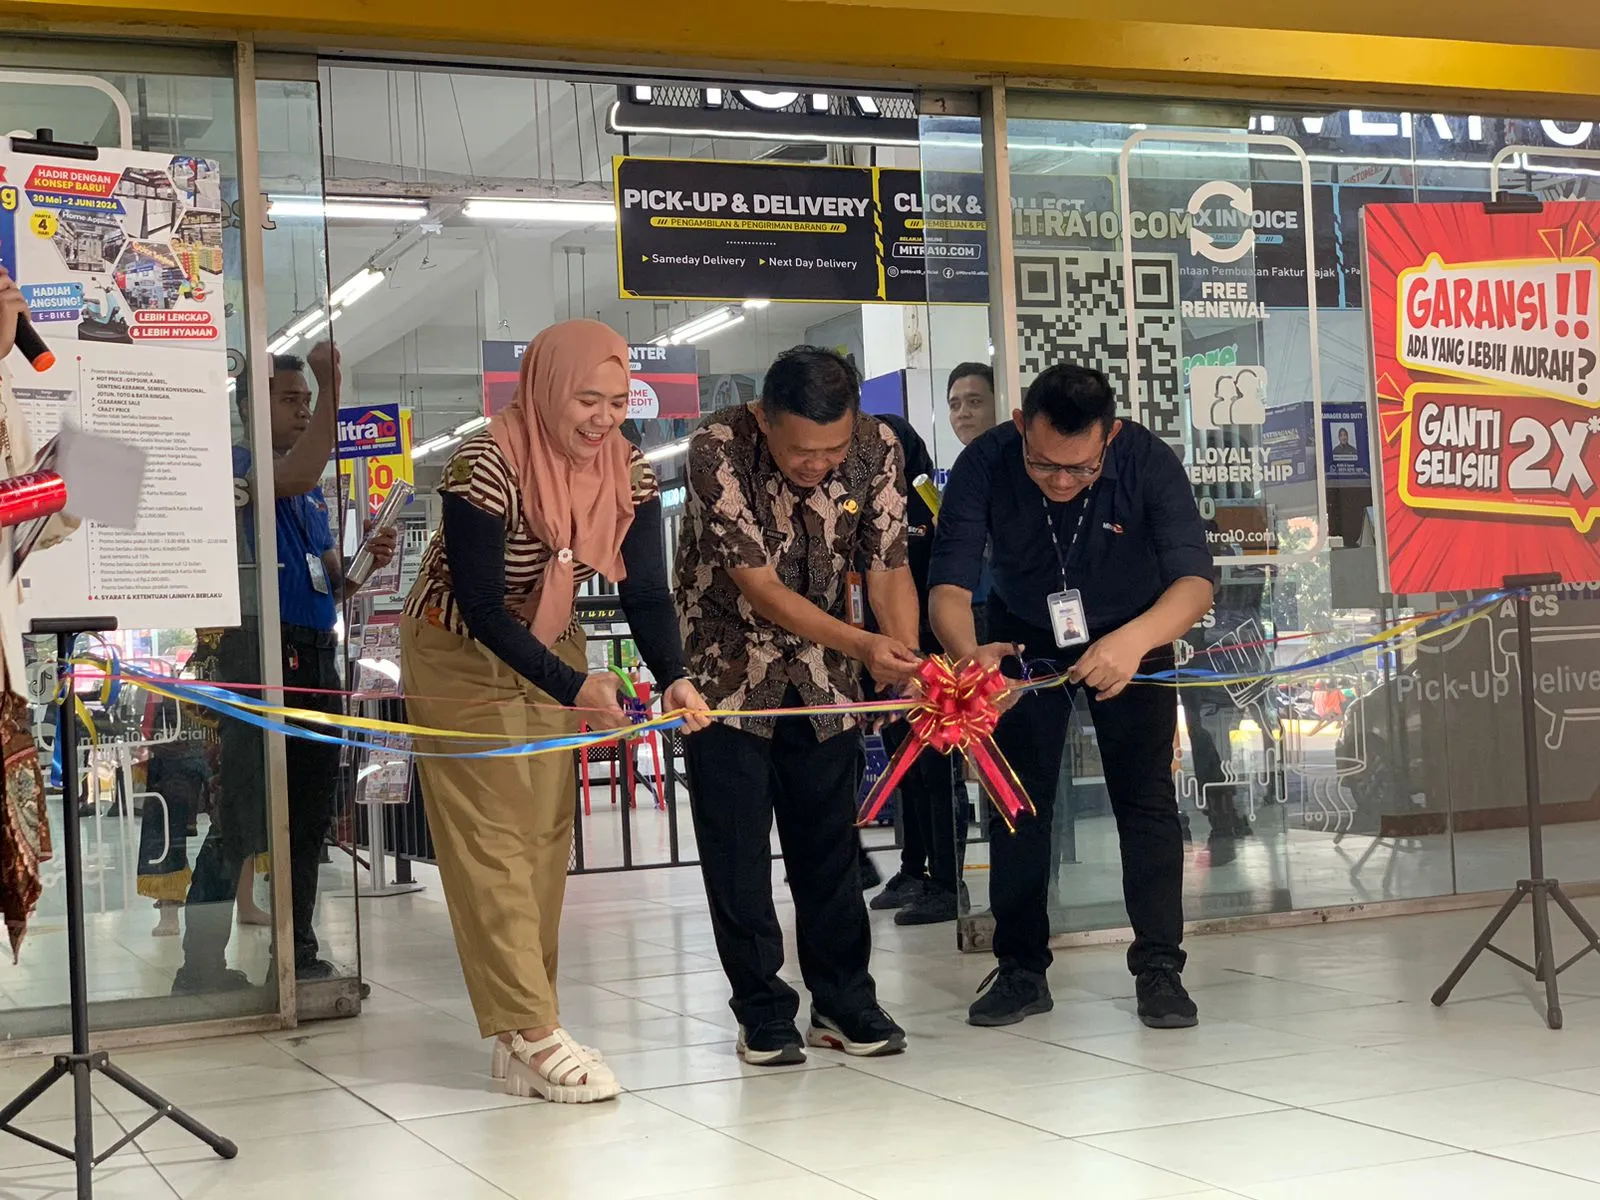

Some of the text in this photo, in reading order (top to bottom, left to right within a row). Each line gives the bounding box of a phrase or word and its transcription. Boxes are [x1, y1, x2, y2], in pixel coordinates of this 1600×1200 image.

[38, 169, 111, 184] HADIR DENGAN
[34, 178, 106, 192] KONSEP BARU!
[33, 194, 44, 202] 30
[46, 196, 62, 204] Mei
[75, 200, 95, 208] JUNI
[96, 200, 118, 210] 2024
[623, 188, 869, 217] PICK-UP & DELIVERY
[894, 192, 983, 214] CLICK &
[38, 218, 48, 230] 4
[670, 218, 828, 232] PENGAMBILAN & PENGIRIMAN BARANG
[925, 220, 967, 229] EMBELIAN
[1014, 208, 1191, 239] ITRA10.COM
[1170, 208, 1213, 227] TX
[899, 245, 975, 257] MITRA10.COM
[652, 253, 746, 269] Sameday Delivery
[768, 257, 858, 271] Next Day Delivery
[1271, 267, 1305, 277] Faktur
[1313, 267, 1336, 280] ajak
[33, 286, 71, 296] HADIAH
[1201, 281, 1248, 299] FREE
[1181, 301, 1270, 319] RENEWAL
[1406, 277, 1548, 331] GARANSI
[39, 312, 72, 320] E-BIKE
[139, 313, 209, 322] LEBIH LENGKAP
[133, 328, 213, 337] & LEBIH NYAMAN
[628, 347, 667, 360] NTER
[1406, 334, 1428, 359] ADA
[1431, 336, 1464, 366] YANG
[1468, 340, 1507, 372] LEBIH
[628, 389, 648, 398] OME
[338, 420, 396, 441] itra10
[1418, 402, 1501, 450] GANTI
[1196, 447, 1272, 465] LOYALTY
[1414, 448, 1499, 488] SELISIH
[1205, 528, 1276, 544] itra10.com
[1398, 673, 1510, 705] Pick-Up
[1531, 669, 1600, 694] elive
